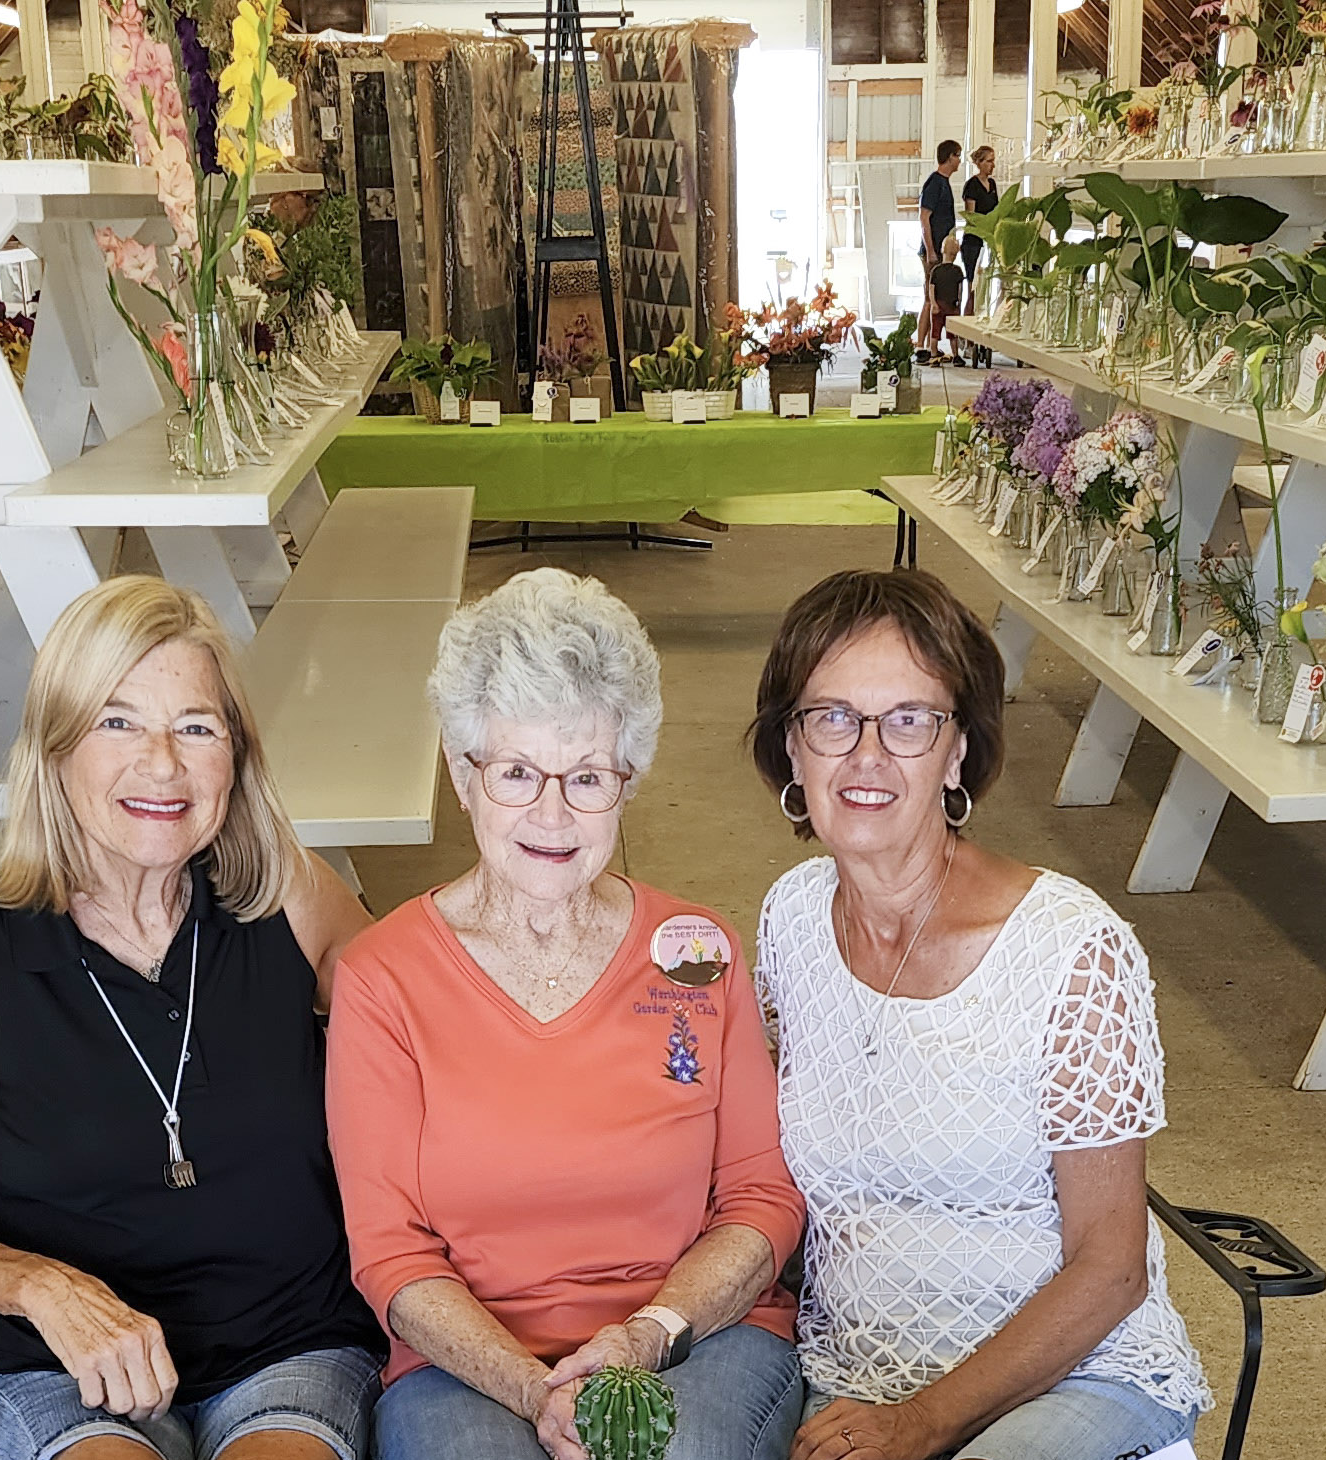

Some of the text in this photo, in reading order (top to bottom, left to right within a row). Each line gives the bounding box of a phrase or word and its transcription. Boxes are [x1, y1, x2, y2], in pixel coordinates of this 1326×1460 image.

[698, 924, 718, 932] know
[674, 931, 695, 939] BEST
[632, 1003, 717, 1016] Garden Club
